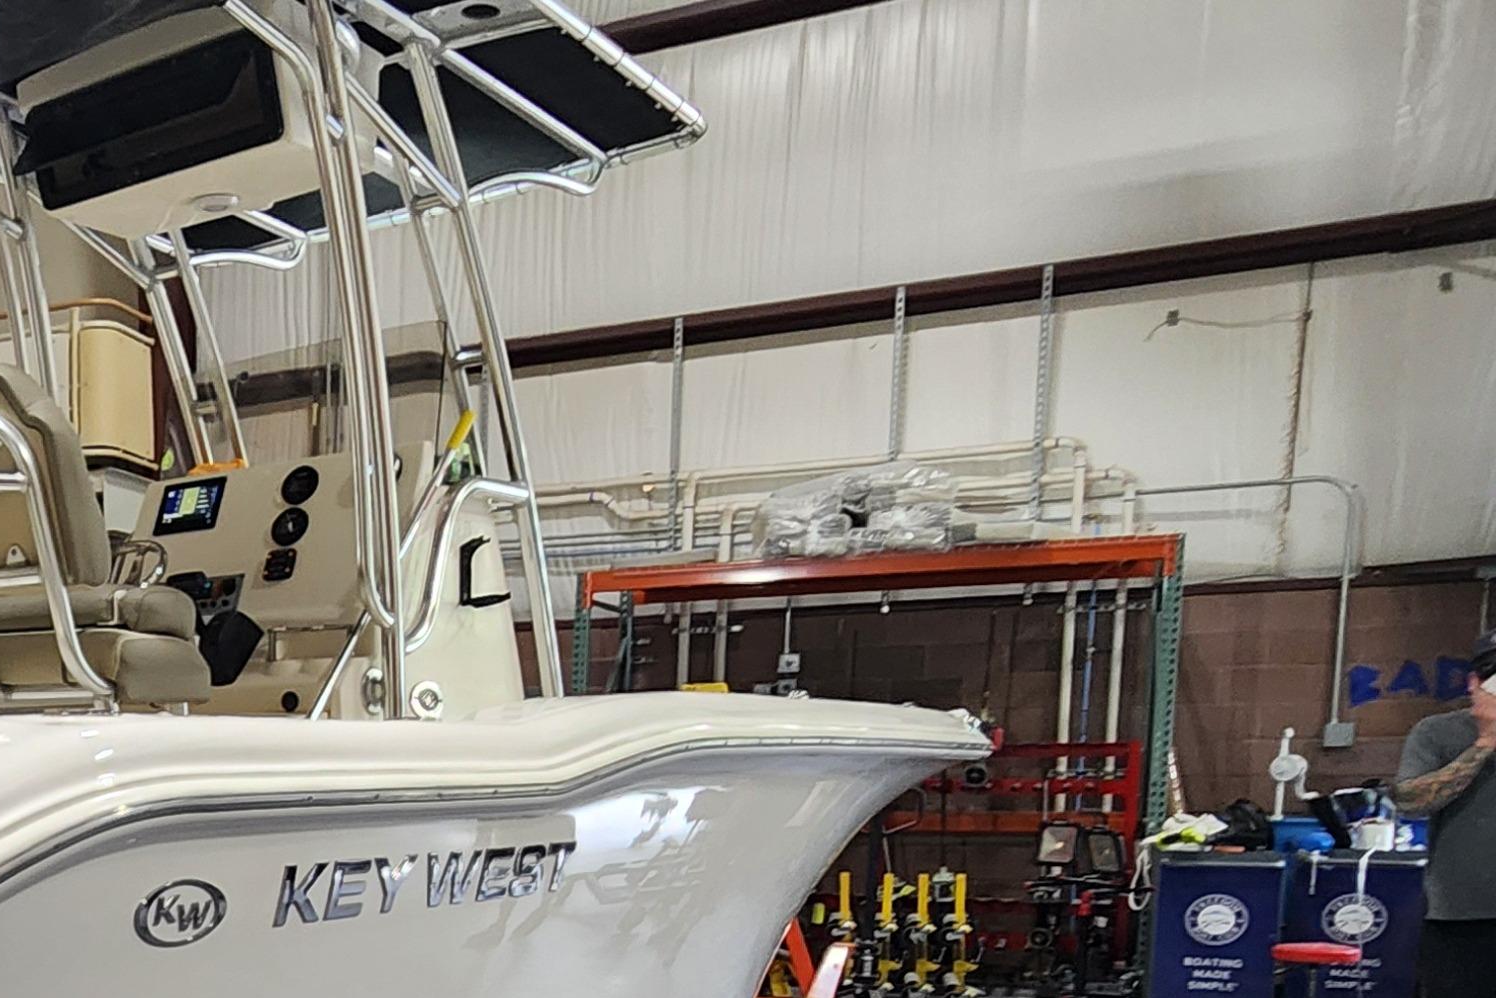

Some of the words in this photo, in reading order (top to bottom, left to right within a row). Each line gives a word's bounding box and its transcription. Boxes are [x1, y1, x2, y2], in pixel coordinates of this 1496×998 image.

[272, 854, 418, 928] KEY
[427, 841, 576, 908] WEST
[152, 894, 212, 933] KW
[1183, 957, 1244, 968] BOATING
[1192, 969, 1232, 980] MADE
